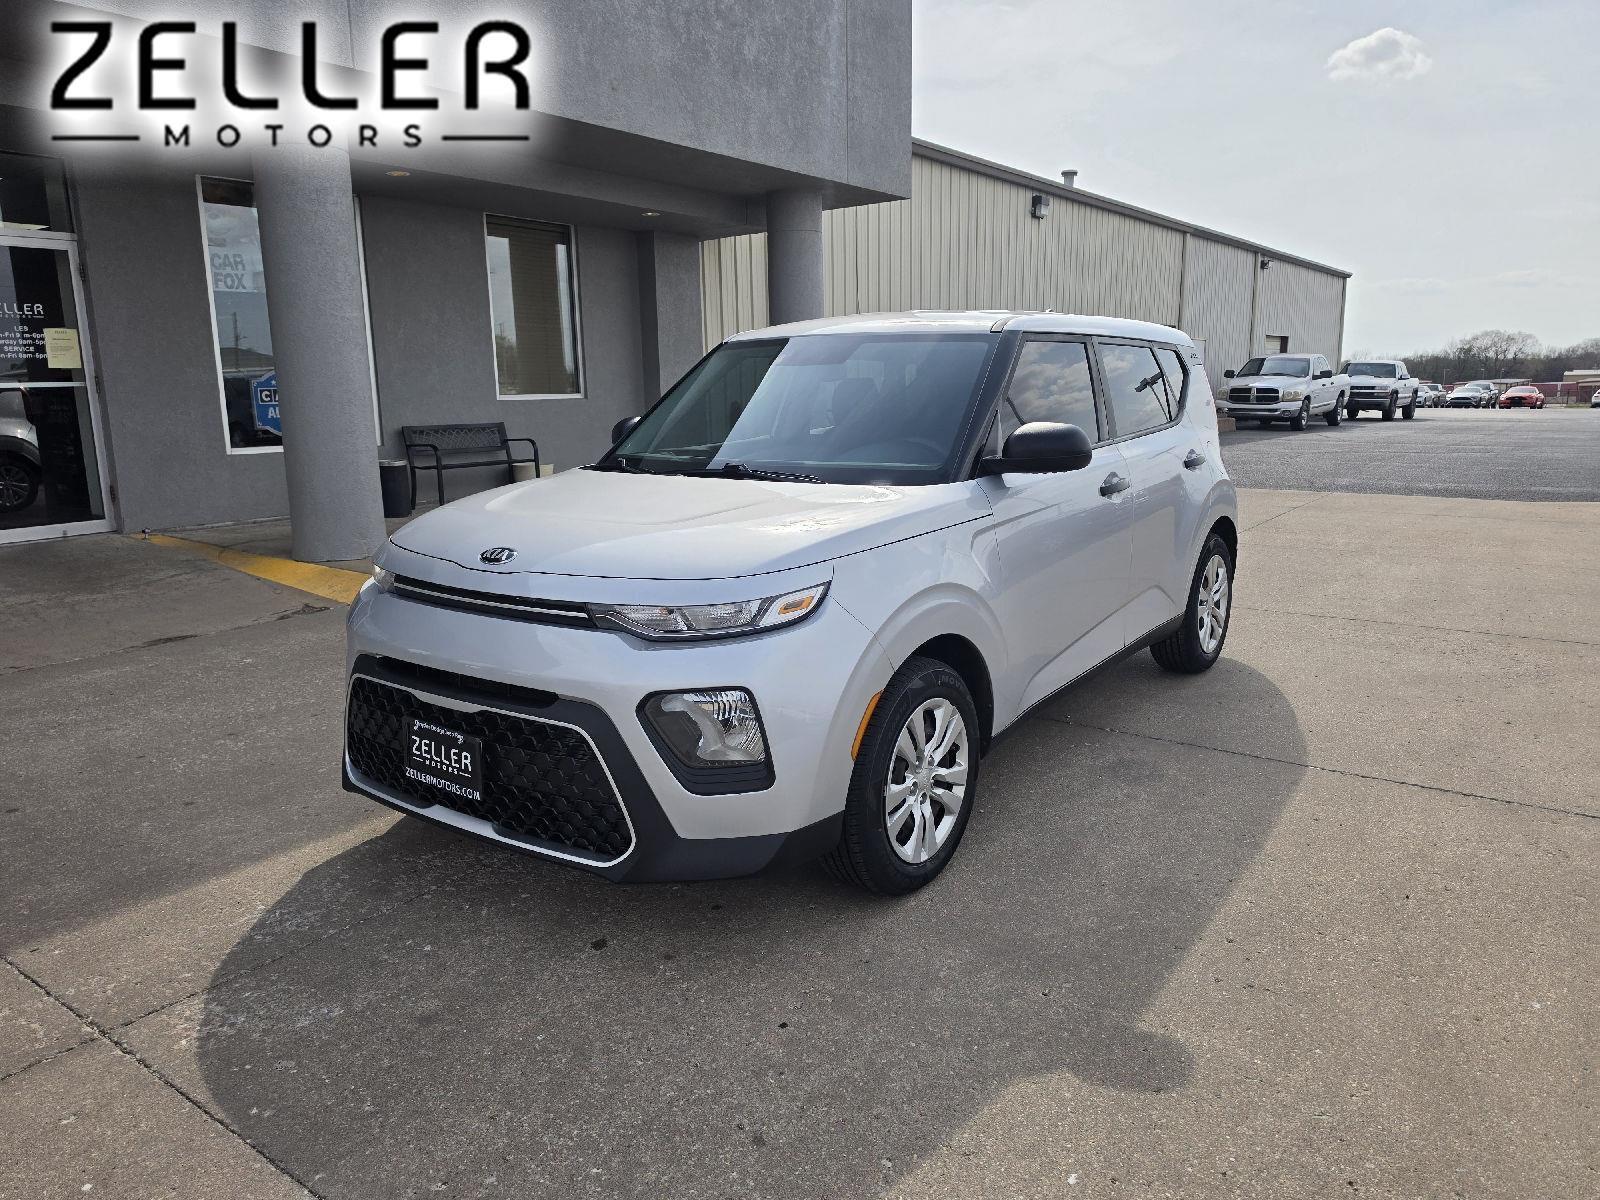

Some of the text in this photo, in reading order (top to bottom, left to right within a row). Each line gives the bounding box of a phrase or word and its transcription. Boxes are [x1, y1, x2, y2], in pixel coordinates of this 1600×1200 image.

[210, 253, 246, 271] CAR
[214, 271, 247, 289] FOX
[0, 303, 44, 315] LLER
[411, 735, 472, 771] ZELLER
[425, 759, 458, 774] MOTORS
[405, 766, 481, 800] ZELLERMOTORS.COM
